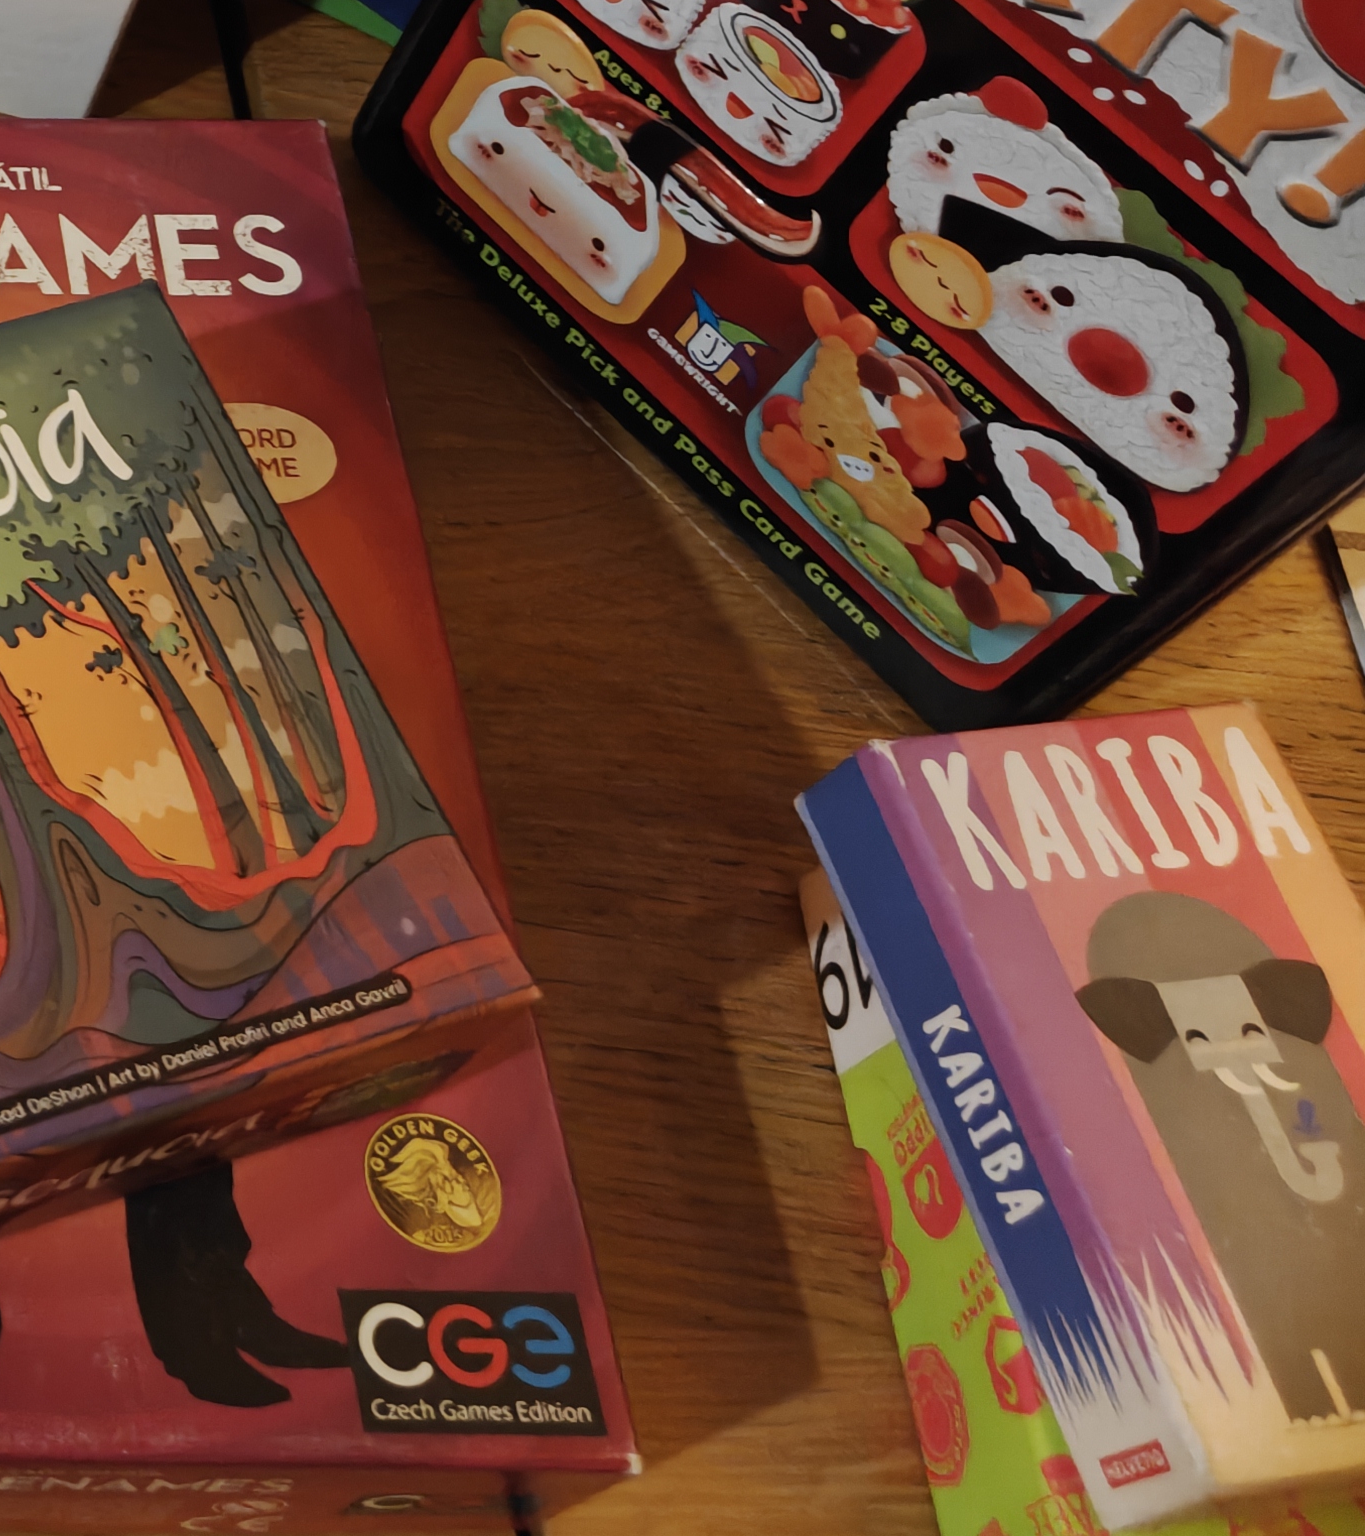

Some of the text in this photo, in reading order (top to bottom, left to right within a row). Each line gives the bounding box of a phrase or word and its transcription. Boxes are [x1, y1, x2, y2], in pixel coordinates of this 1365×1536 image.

[593, 48, 644, 97] Ages
[867, 296, 997, 417] 2-8 Players
[236, 427, 297, 449] ORD
[478, 242, 882, 641] Deluxe Pick and Pass Card Game
[921, 727, 1312, 891] KARIBA
[29, 1081, 97, 1117] DeShon
[107, 1066, 135, 1089] Art
[137, 1059, 162, 1084] by
[162, 1038, 218, 1071] Daniel
[271, 1008, 308, 1035] and
[309, 997, 355, 1025] Anca
[921, 1004, 1046, 1226] KARIBA
[370, 1119, 489, 1175] GOLDEN GEEK
[370, 1397, 594, 1426] Czech Games Edition
